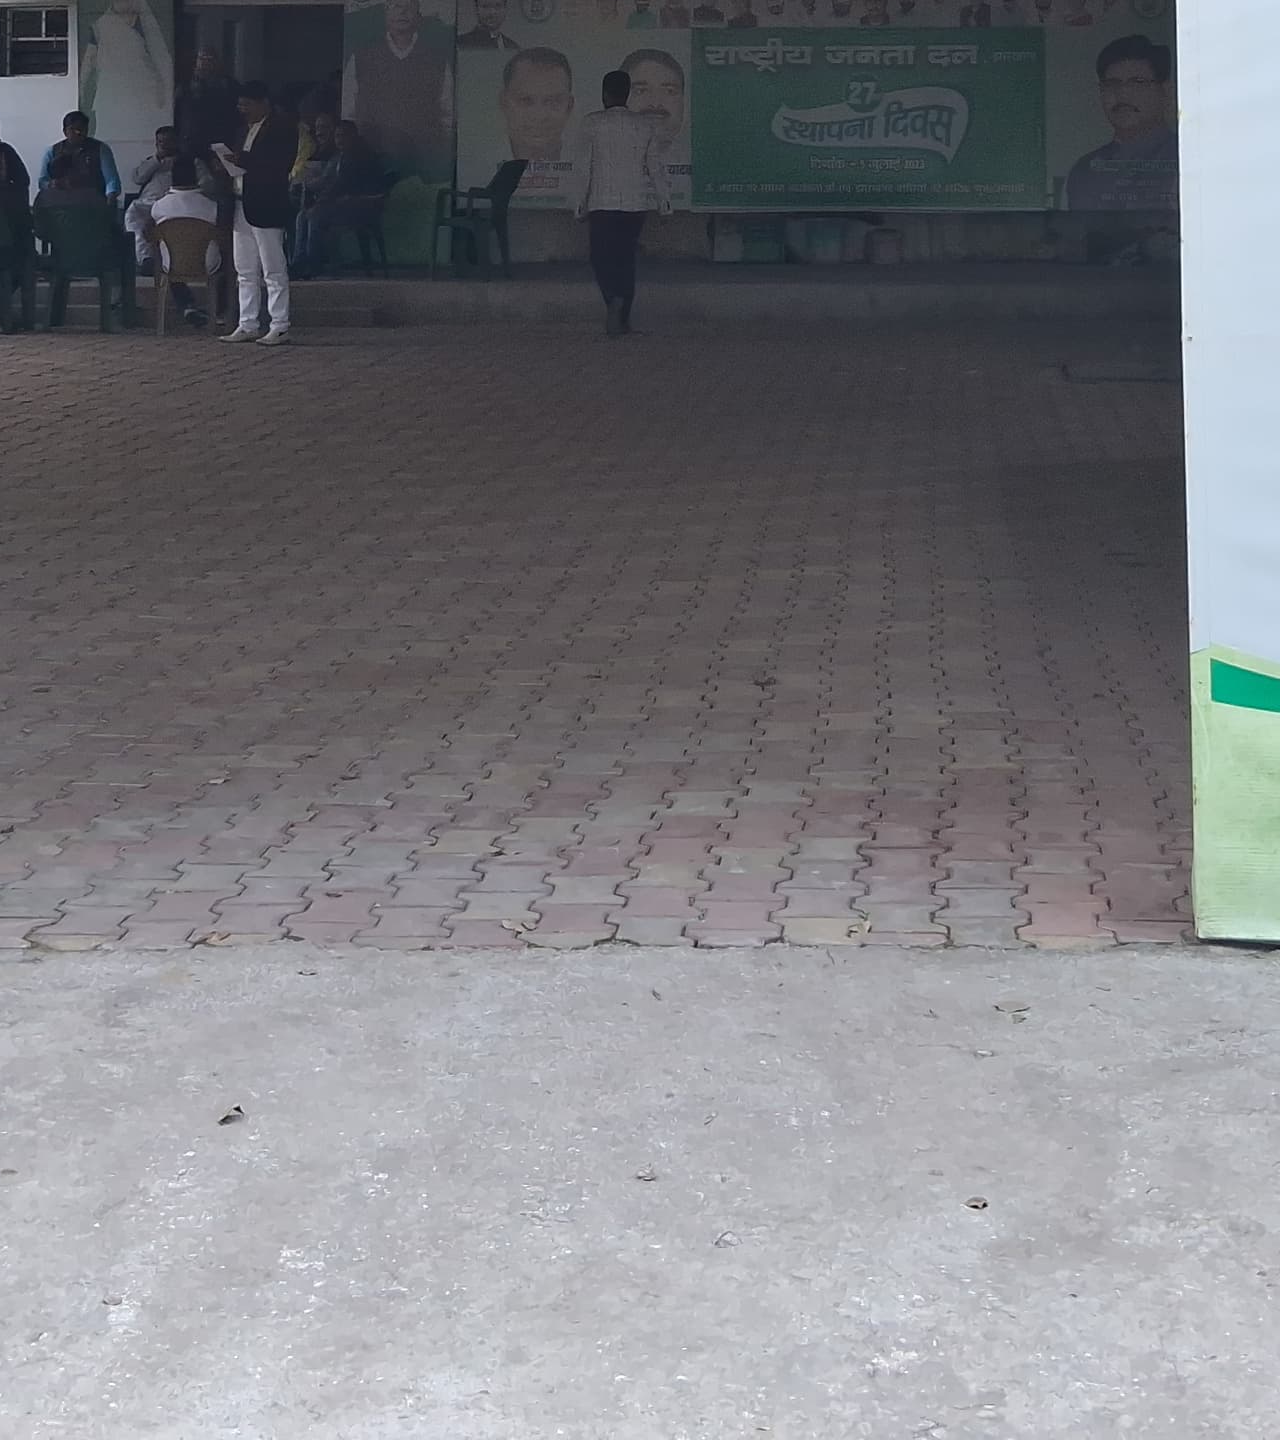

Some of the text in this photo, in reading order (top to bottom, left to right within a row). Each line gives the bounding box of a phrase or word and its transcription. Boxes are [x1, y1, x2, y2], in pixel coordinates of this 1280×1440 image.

[704, 38, 813, 72] राष्ट्रीय
[824, 45, 916, 66] जनता
[849, 81, 877, 105] 27
[782, 100, 959, 146] स्थापना दिवस
